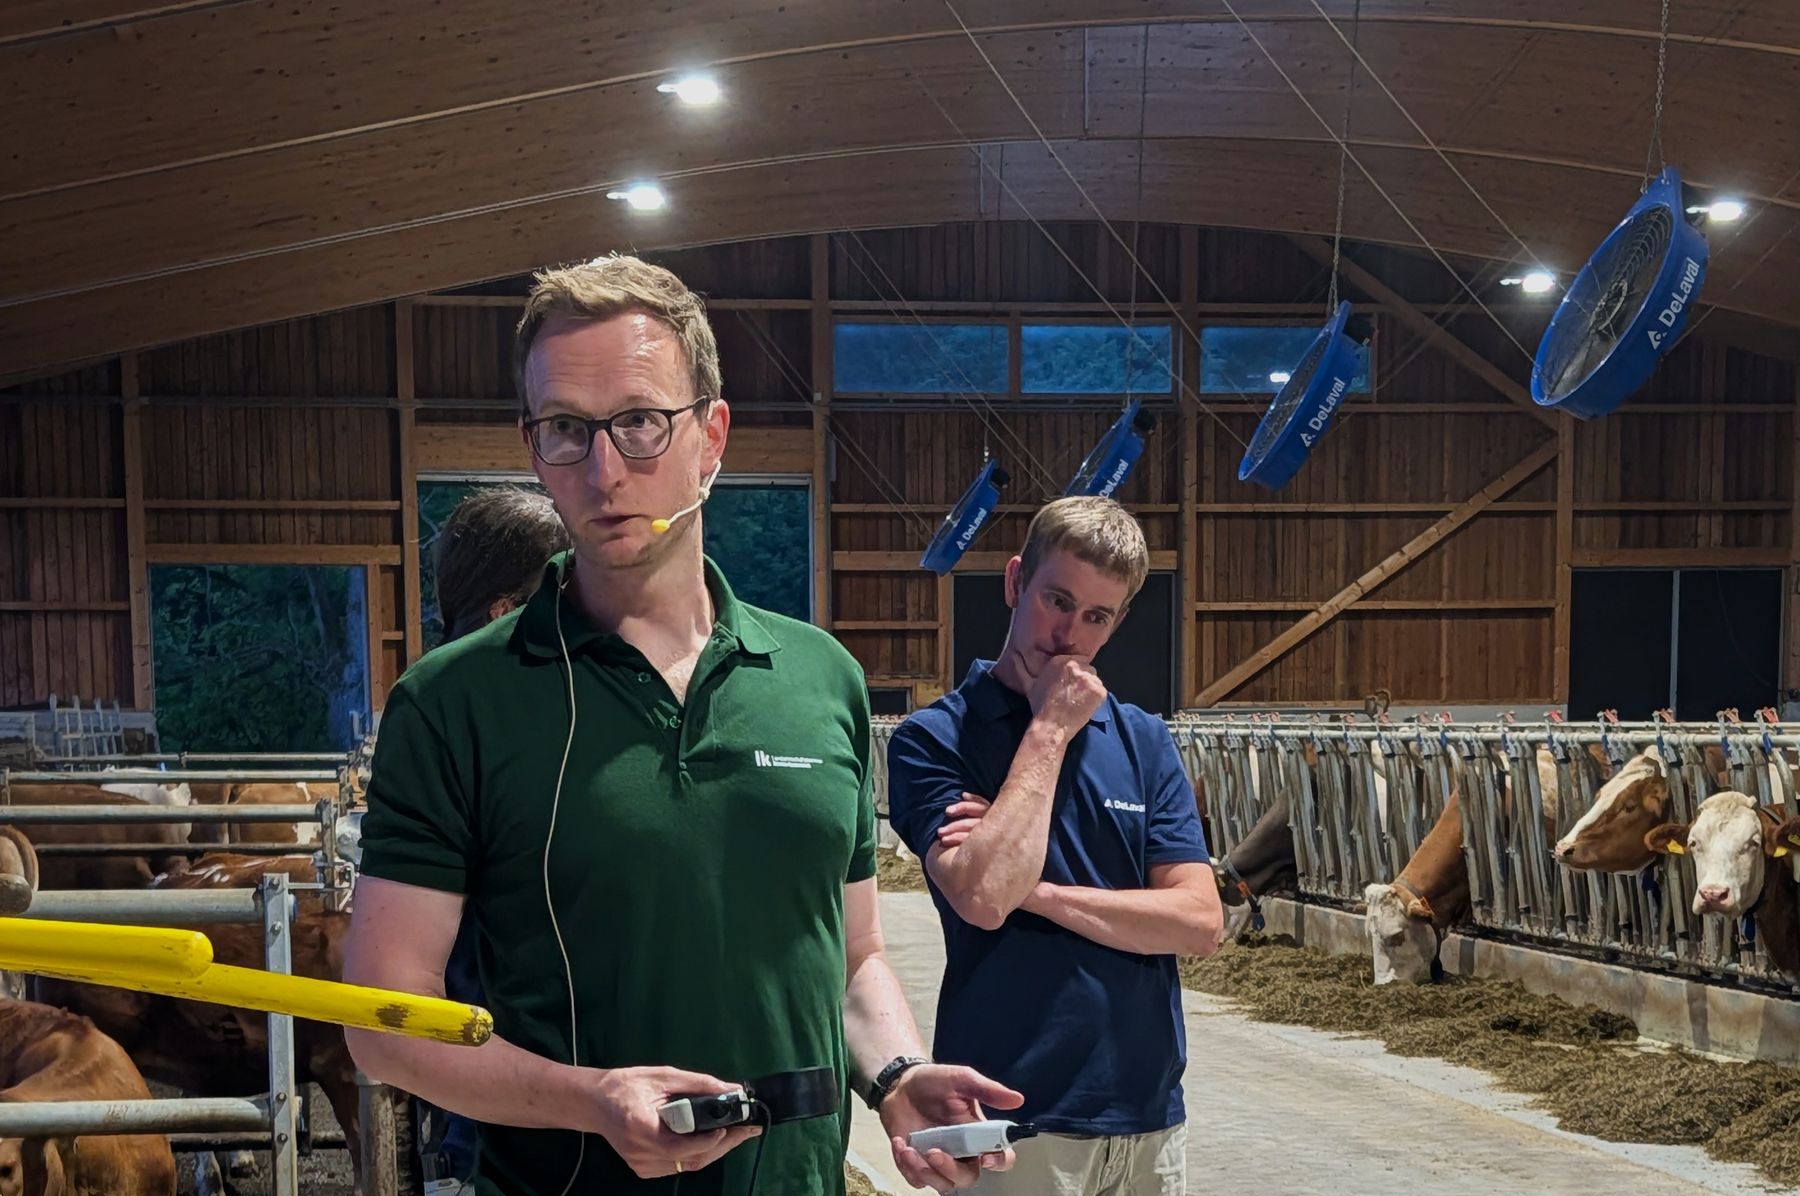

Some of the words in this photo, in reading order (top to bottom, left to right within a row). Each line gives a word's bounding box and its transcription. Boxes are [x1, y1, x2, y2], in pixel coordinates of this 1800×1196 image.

[1658, 257, 1700, 328] DeLaval
[1308, 377, 1346, 431] DeLaval
[1099, 459, 1129, 499] DeLaval
[961, 507, 988, 541] DeLaval
